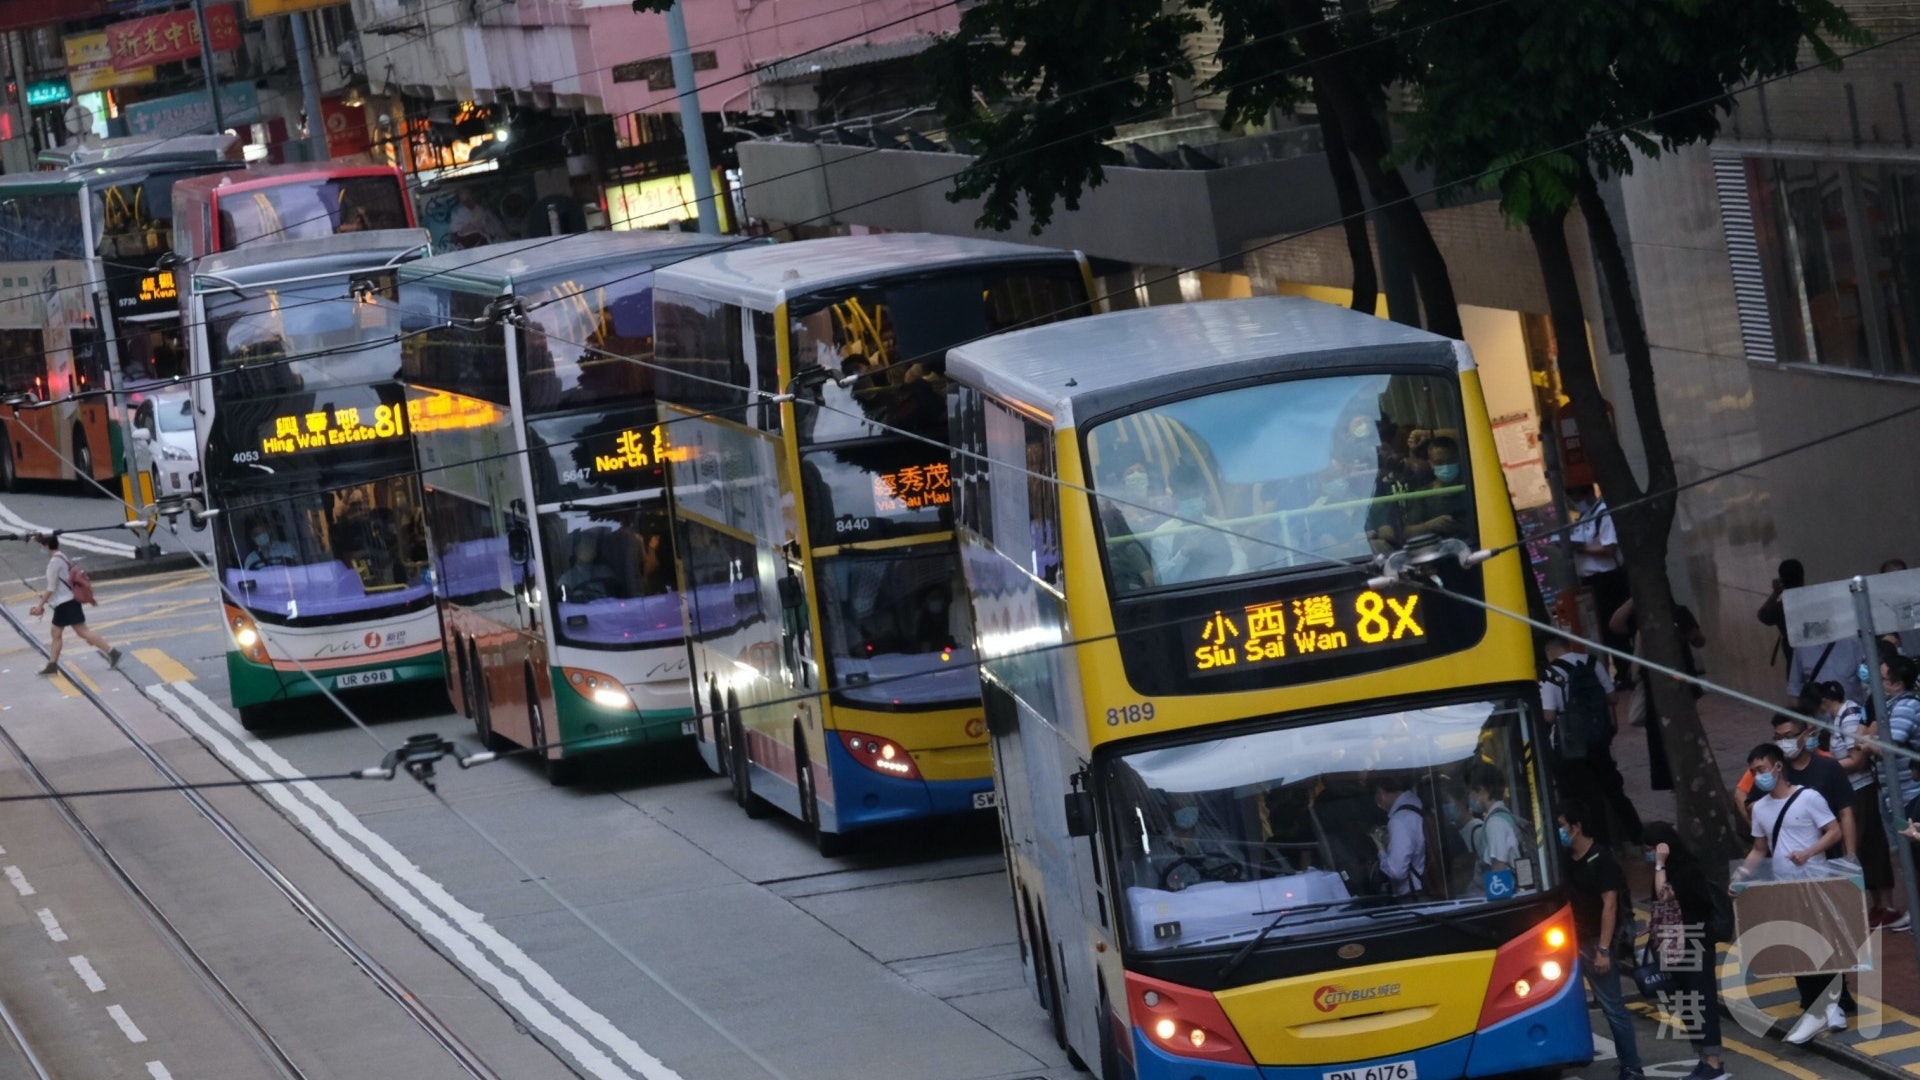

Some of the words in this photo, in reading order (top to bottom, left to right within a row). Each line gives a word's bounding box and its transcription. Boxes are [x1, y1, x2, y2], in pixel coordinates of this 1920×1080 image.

[374, 402, 403, 438] 81
[263, 435, 295, 453] Hing
[297, 432, 326, 448] Wah
[328, 425, 376, 445] Estate
[232, 451, 259, 463] 4053
[596, 451, 648, 472] North
[562, 467, 591, 483] 5647
[873, 462, 951, 497] 經秀茂
[876, 500, 896, 511] via
[899, 493, 922, 509] Sau
[923, 490, 951, 506] Mau
[836, 518, 870, 533] 8440
[1201, 594, 1336, 646] 小西灣
[1354, 590, 1425, 644] 8X
[1195, 644, 1237, 670] Siu
[1245, 636, 1286, 662] Sai
[1294, 628, 1348, 654] Wan
[342, 674, 358, 686] UR
[362, 671, 388, 684] 698
[1106, 702, 1156, 727] 8189
[1323, 986, 1377, 1005] CITYBUS
[1365, 1063, 1409, 1080] 6176
